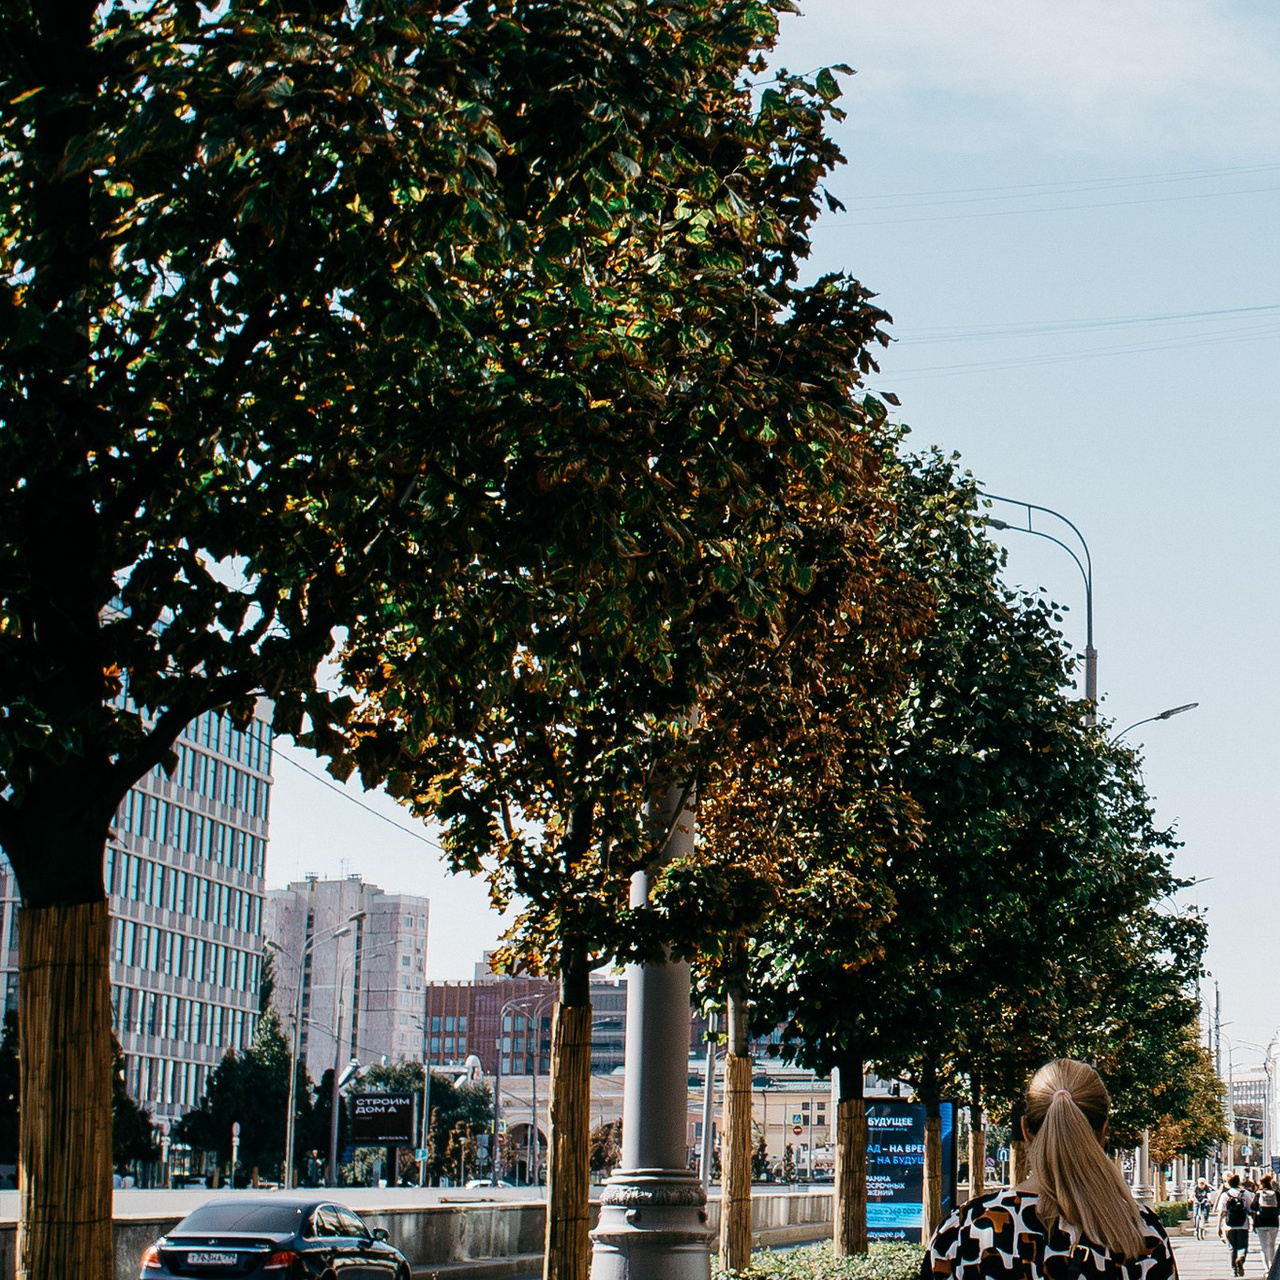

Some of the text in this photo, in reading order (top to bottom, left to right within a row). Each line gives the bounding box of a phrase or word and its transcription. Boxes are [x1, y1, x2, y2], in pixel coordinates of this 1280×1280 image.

[355, 1106, 386, 1114] ДОМ
[867, 1117, 913, 1126] БУДУЩЕЕ
[866, 1144, 881, 1153] АД
[889, 1144, 904, 1153] НА
[905, 1144, 926, 1153] ВРЕ
[876, 1155, 891, 1164] НА
